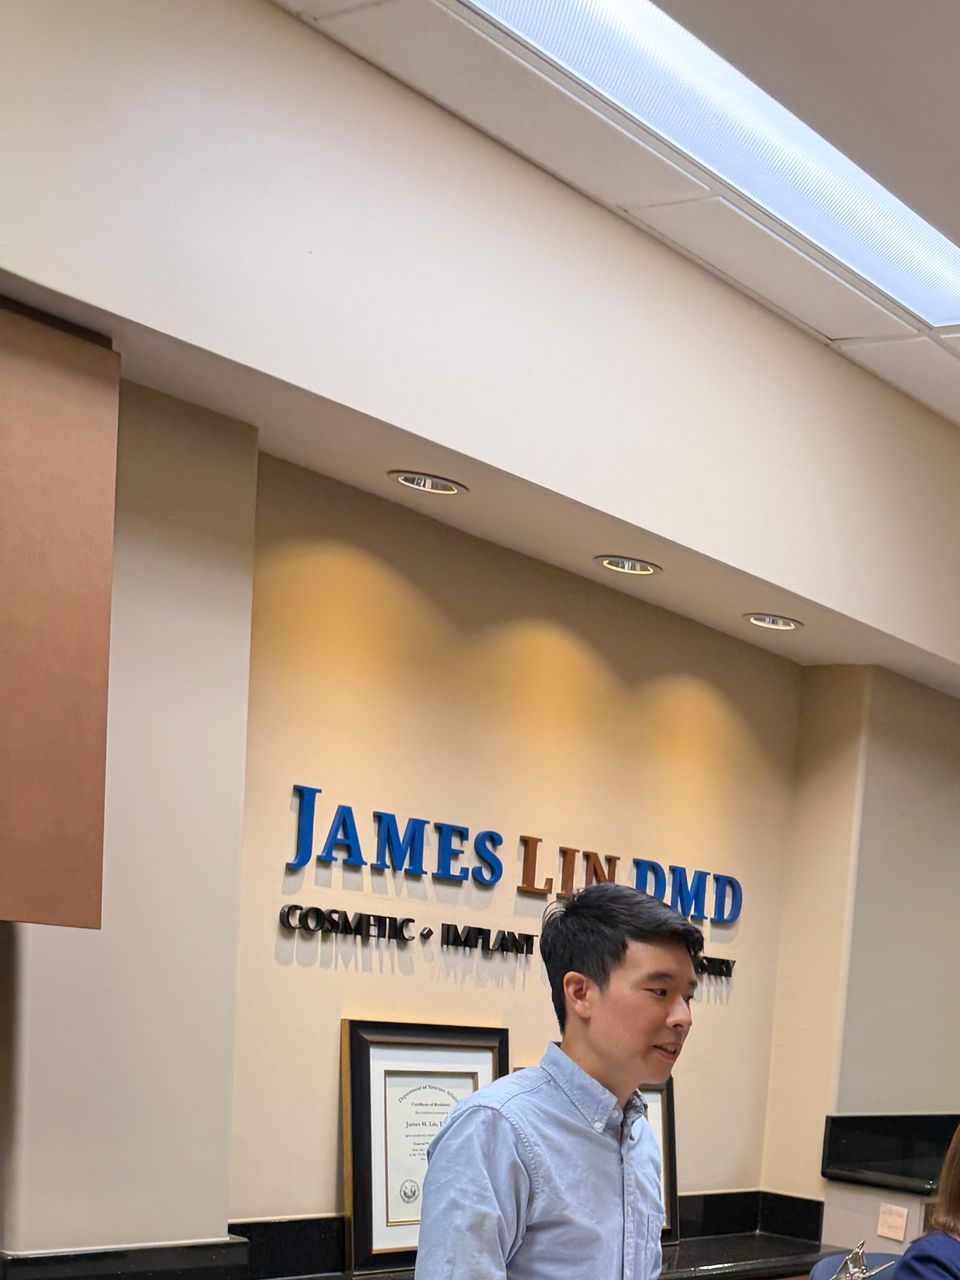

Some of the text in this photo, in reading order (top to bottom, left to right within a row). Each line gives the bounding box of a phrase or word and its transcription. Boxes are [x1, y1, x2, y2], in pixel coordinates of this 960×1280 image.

[285, 784, 744, 926] JAMES LIN DMD
[279, 904, 539, 955] COSMETIC IMPLANT
